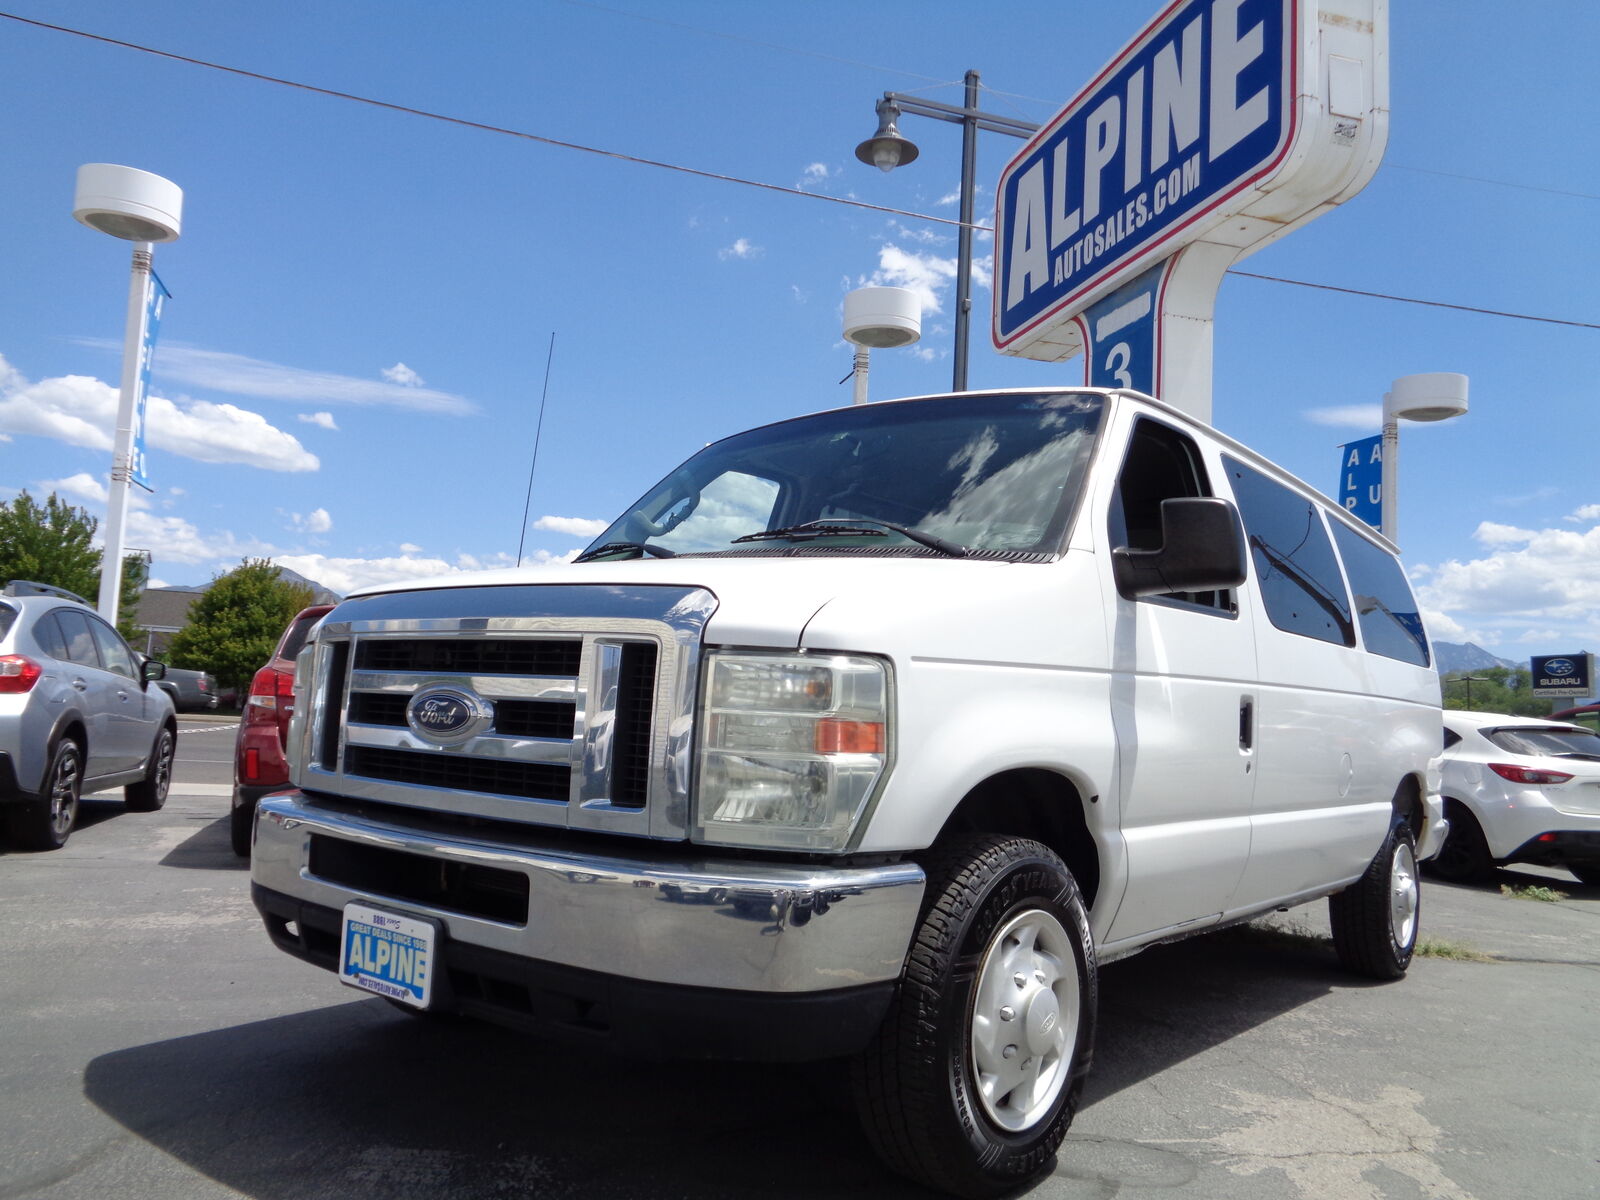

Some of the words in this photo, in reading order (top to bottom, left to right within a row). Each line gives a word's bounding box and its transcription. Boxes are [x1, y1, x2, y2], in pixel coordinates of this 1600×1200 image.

[1006, 0, 1270, 313] ALPINE
[1053, 152, 1200, 288] AUTOSALES.COM
[1104, 341, 1132, 388] 3
[1540, 678, 1580, 686] SUBARU
[420, 699, 457, 725] Ford
[348, 932, 427, 989] ALPINE
